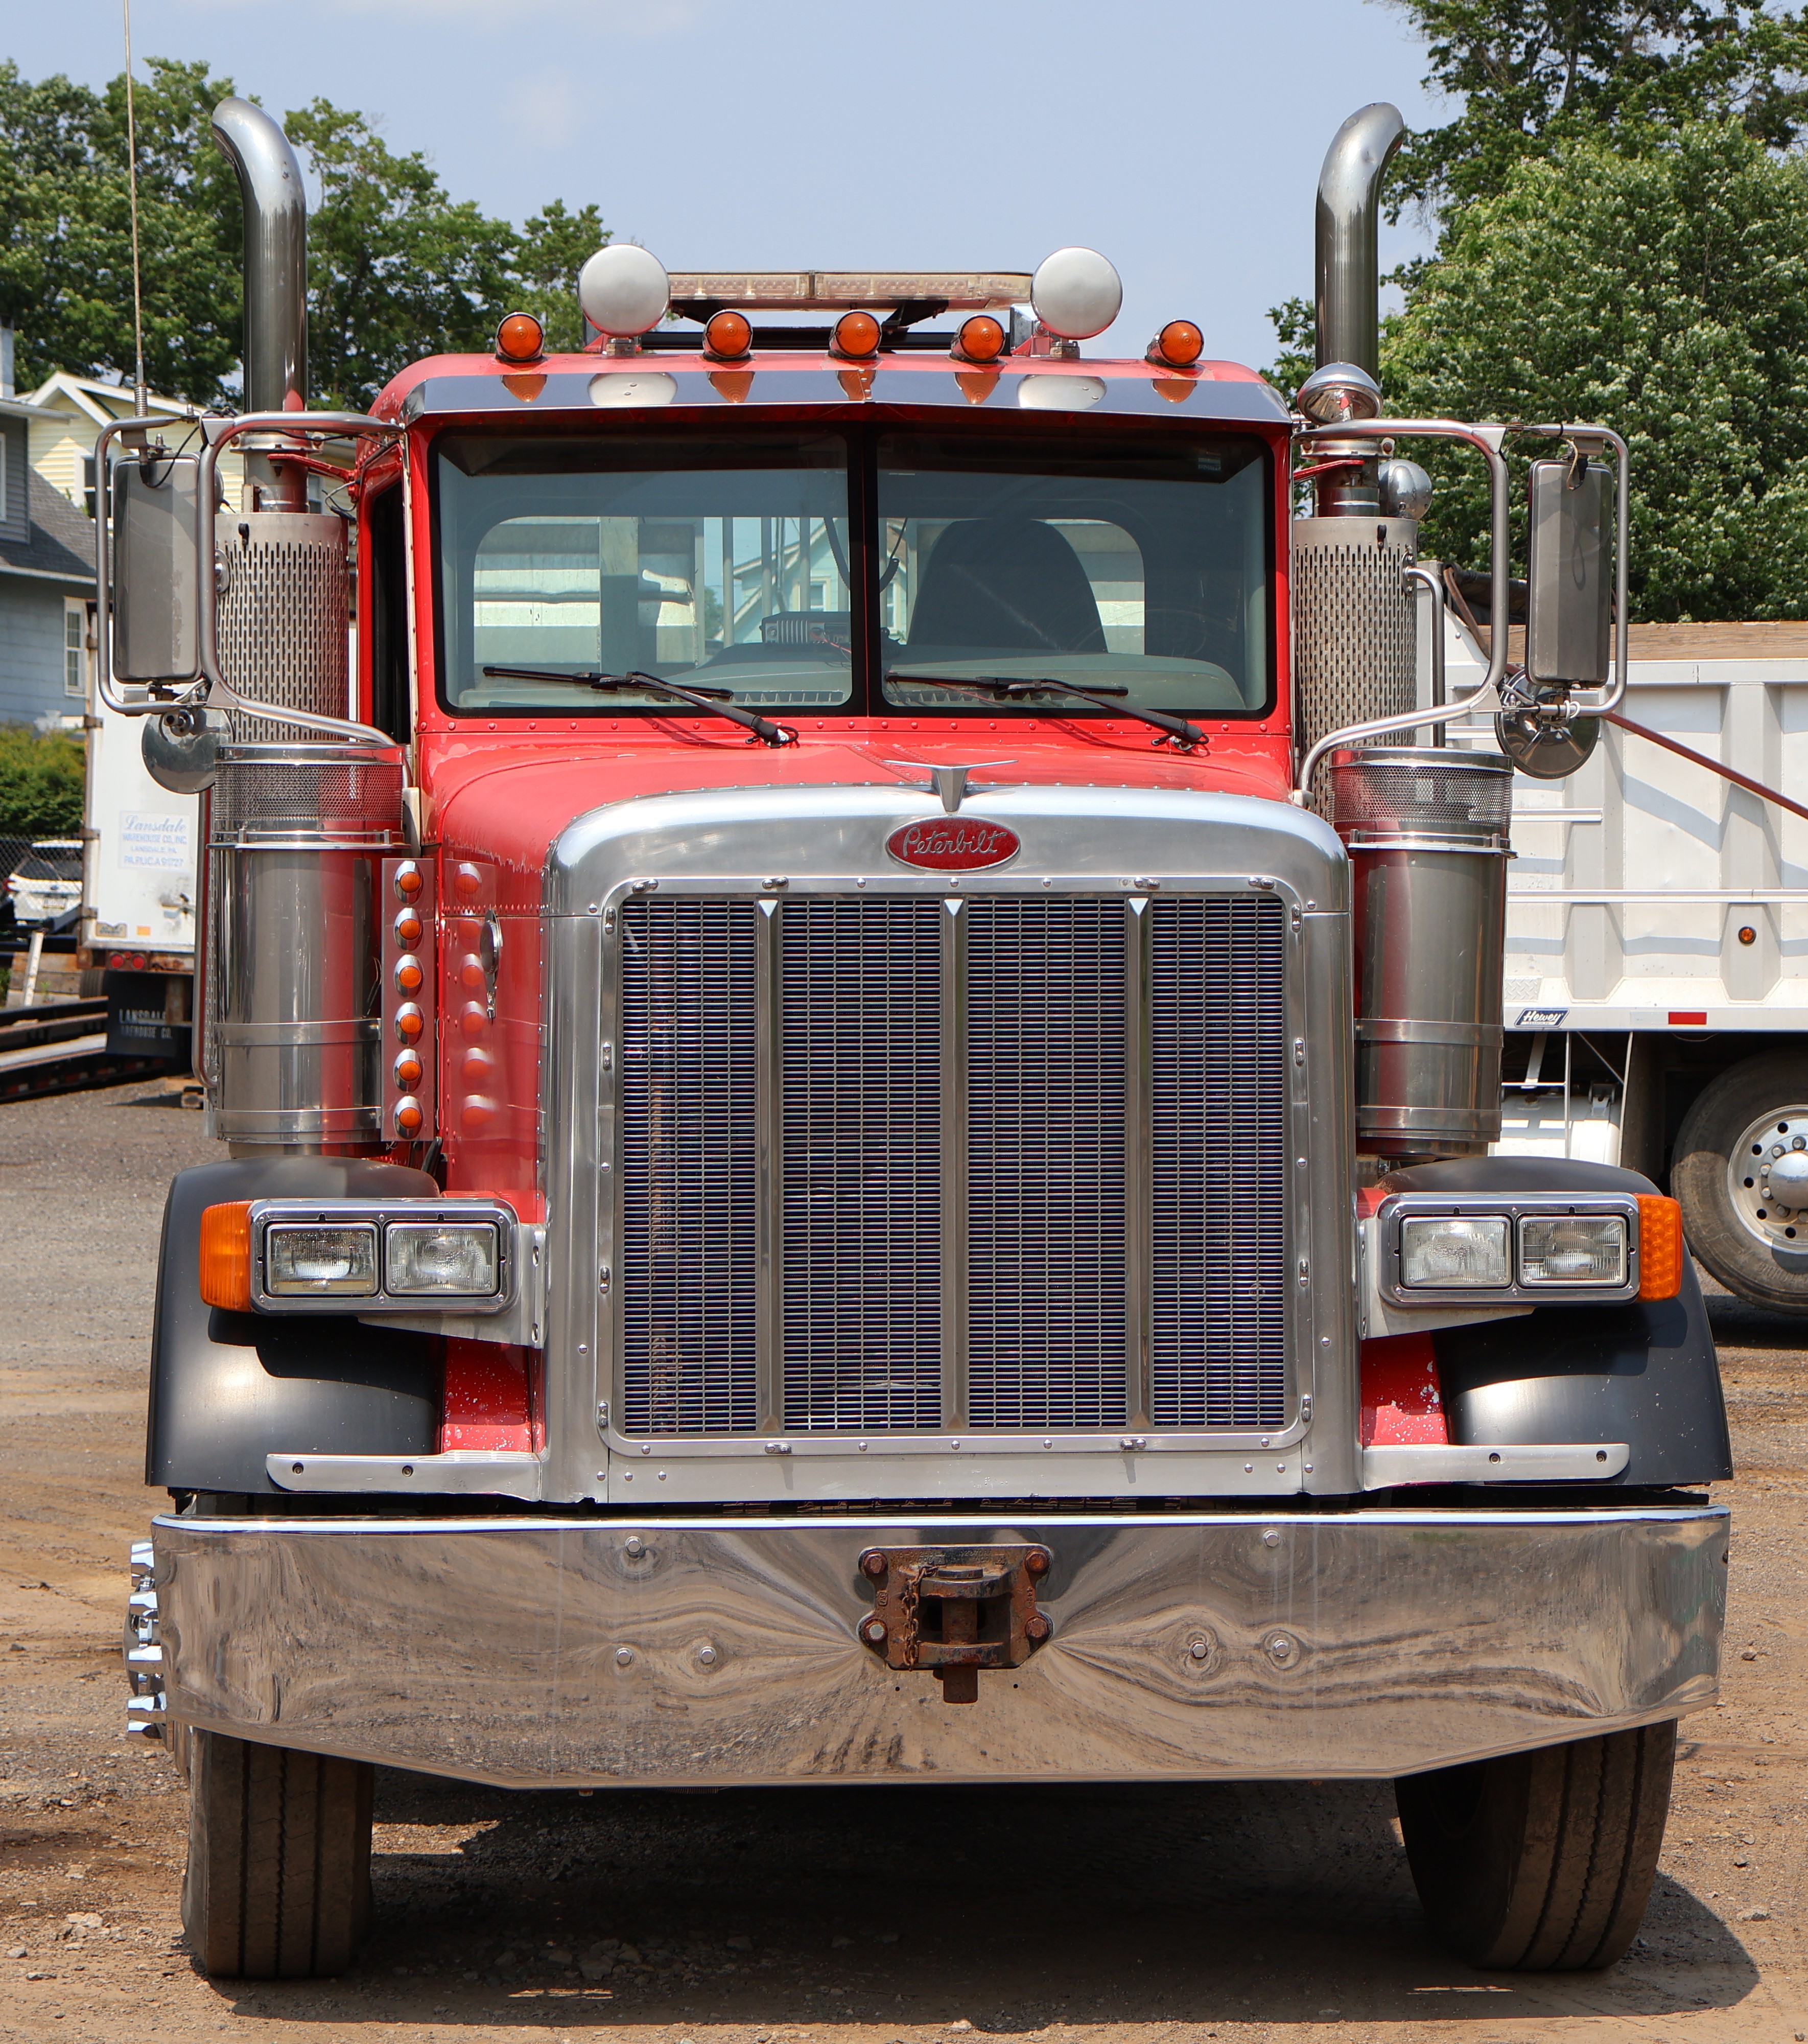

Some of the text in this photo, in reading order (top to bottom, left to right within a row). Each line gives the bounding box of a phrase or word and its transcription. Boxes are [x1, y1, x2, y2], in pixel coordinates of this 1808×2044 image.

[123, 815, 186, 832] Lansdale
[903, 826, 1007, 857] Peterbilt
[1523, 1010, 1561, 1022] Hewey
